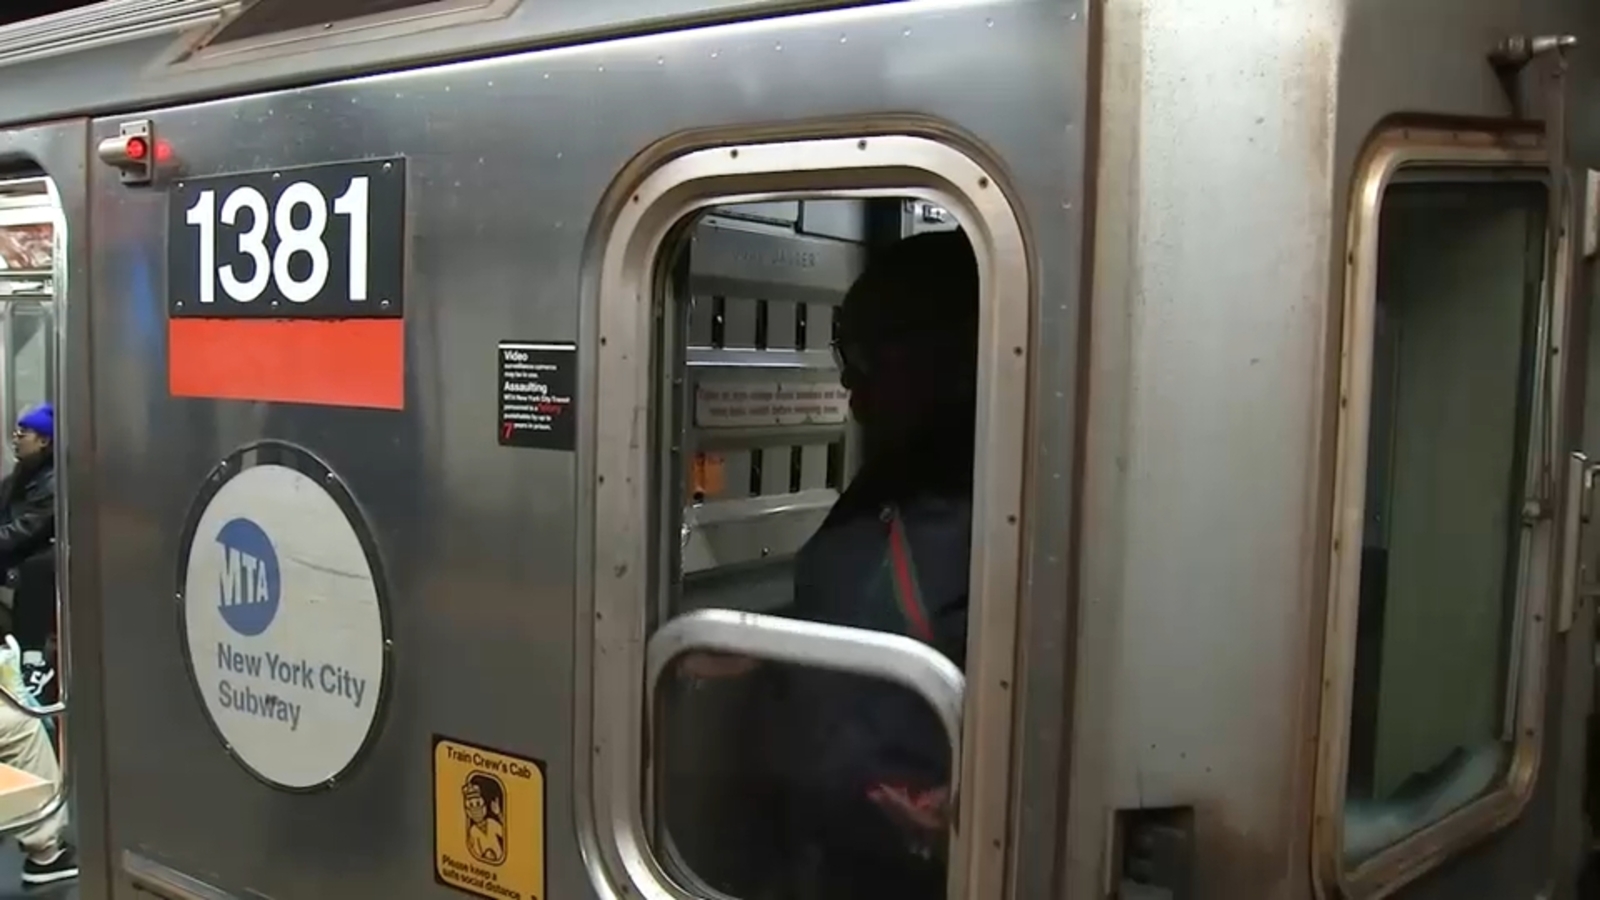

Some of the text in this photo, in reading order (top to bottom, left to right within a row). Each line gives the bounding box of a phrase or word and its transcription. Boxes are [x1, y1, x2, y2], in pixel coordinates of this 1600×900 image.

[186, 176, 369, 303] 1381
[504, 350, 529, 361] Video
[504, 381, 548, 395] Assaulting
[516, 394, 527, 402] New
[528, 395, 540, 403] York
[541, 395, 551, 404] City
[552, 395, 571, 403] Transit
[504, 422, 513, 439] 7
[218, 544, 269, 607] MTA
[217, 642, 366, 708] New York City
[218, 679, 301, 732] Subway
[446, 746, 531, 780] Train Crew's Cab
[442, 854, 498, 881] Please keep a
[442, 868, 521, 900] safe social distance
